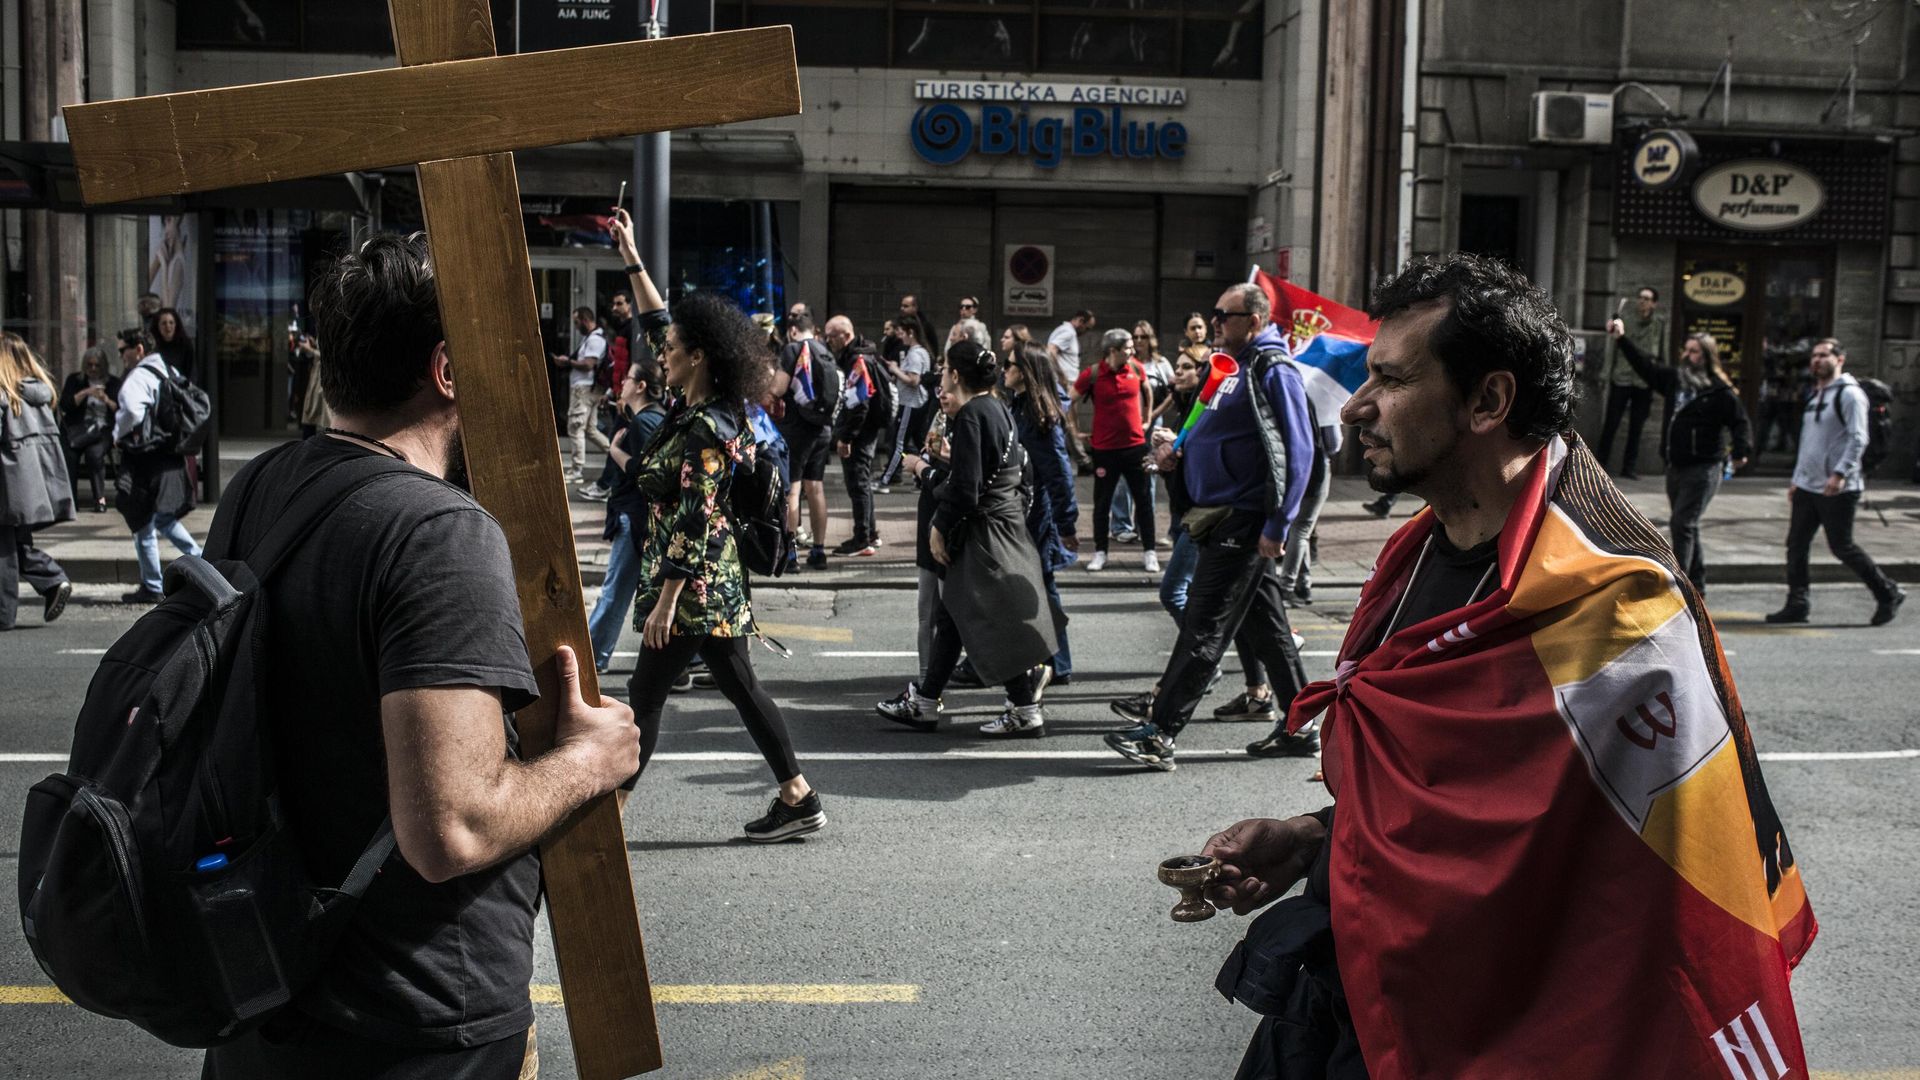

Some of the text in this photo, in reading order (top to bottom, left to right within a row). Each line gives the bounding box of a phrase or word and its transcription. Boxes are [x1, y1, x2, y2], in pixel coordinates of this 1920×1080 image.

[558, 8, 611, 20] AJA JUNG
[916, 81, 1185, 104] TURISTIČKA AGENCIJA
[979, 103, 1188, 169] Big Blue
[1719, 198, 1799, 218] perfumum
